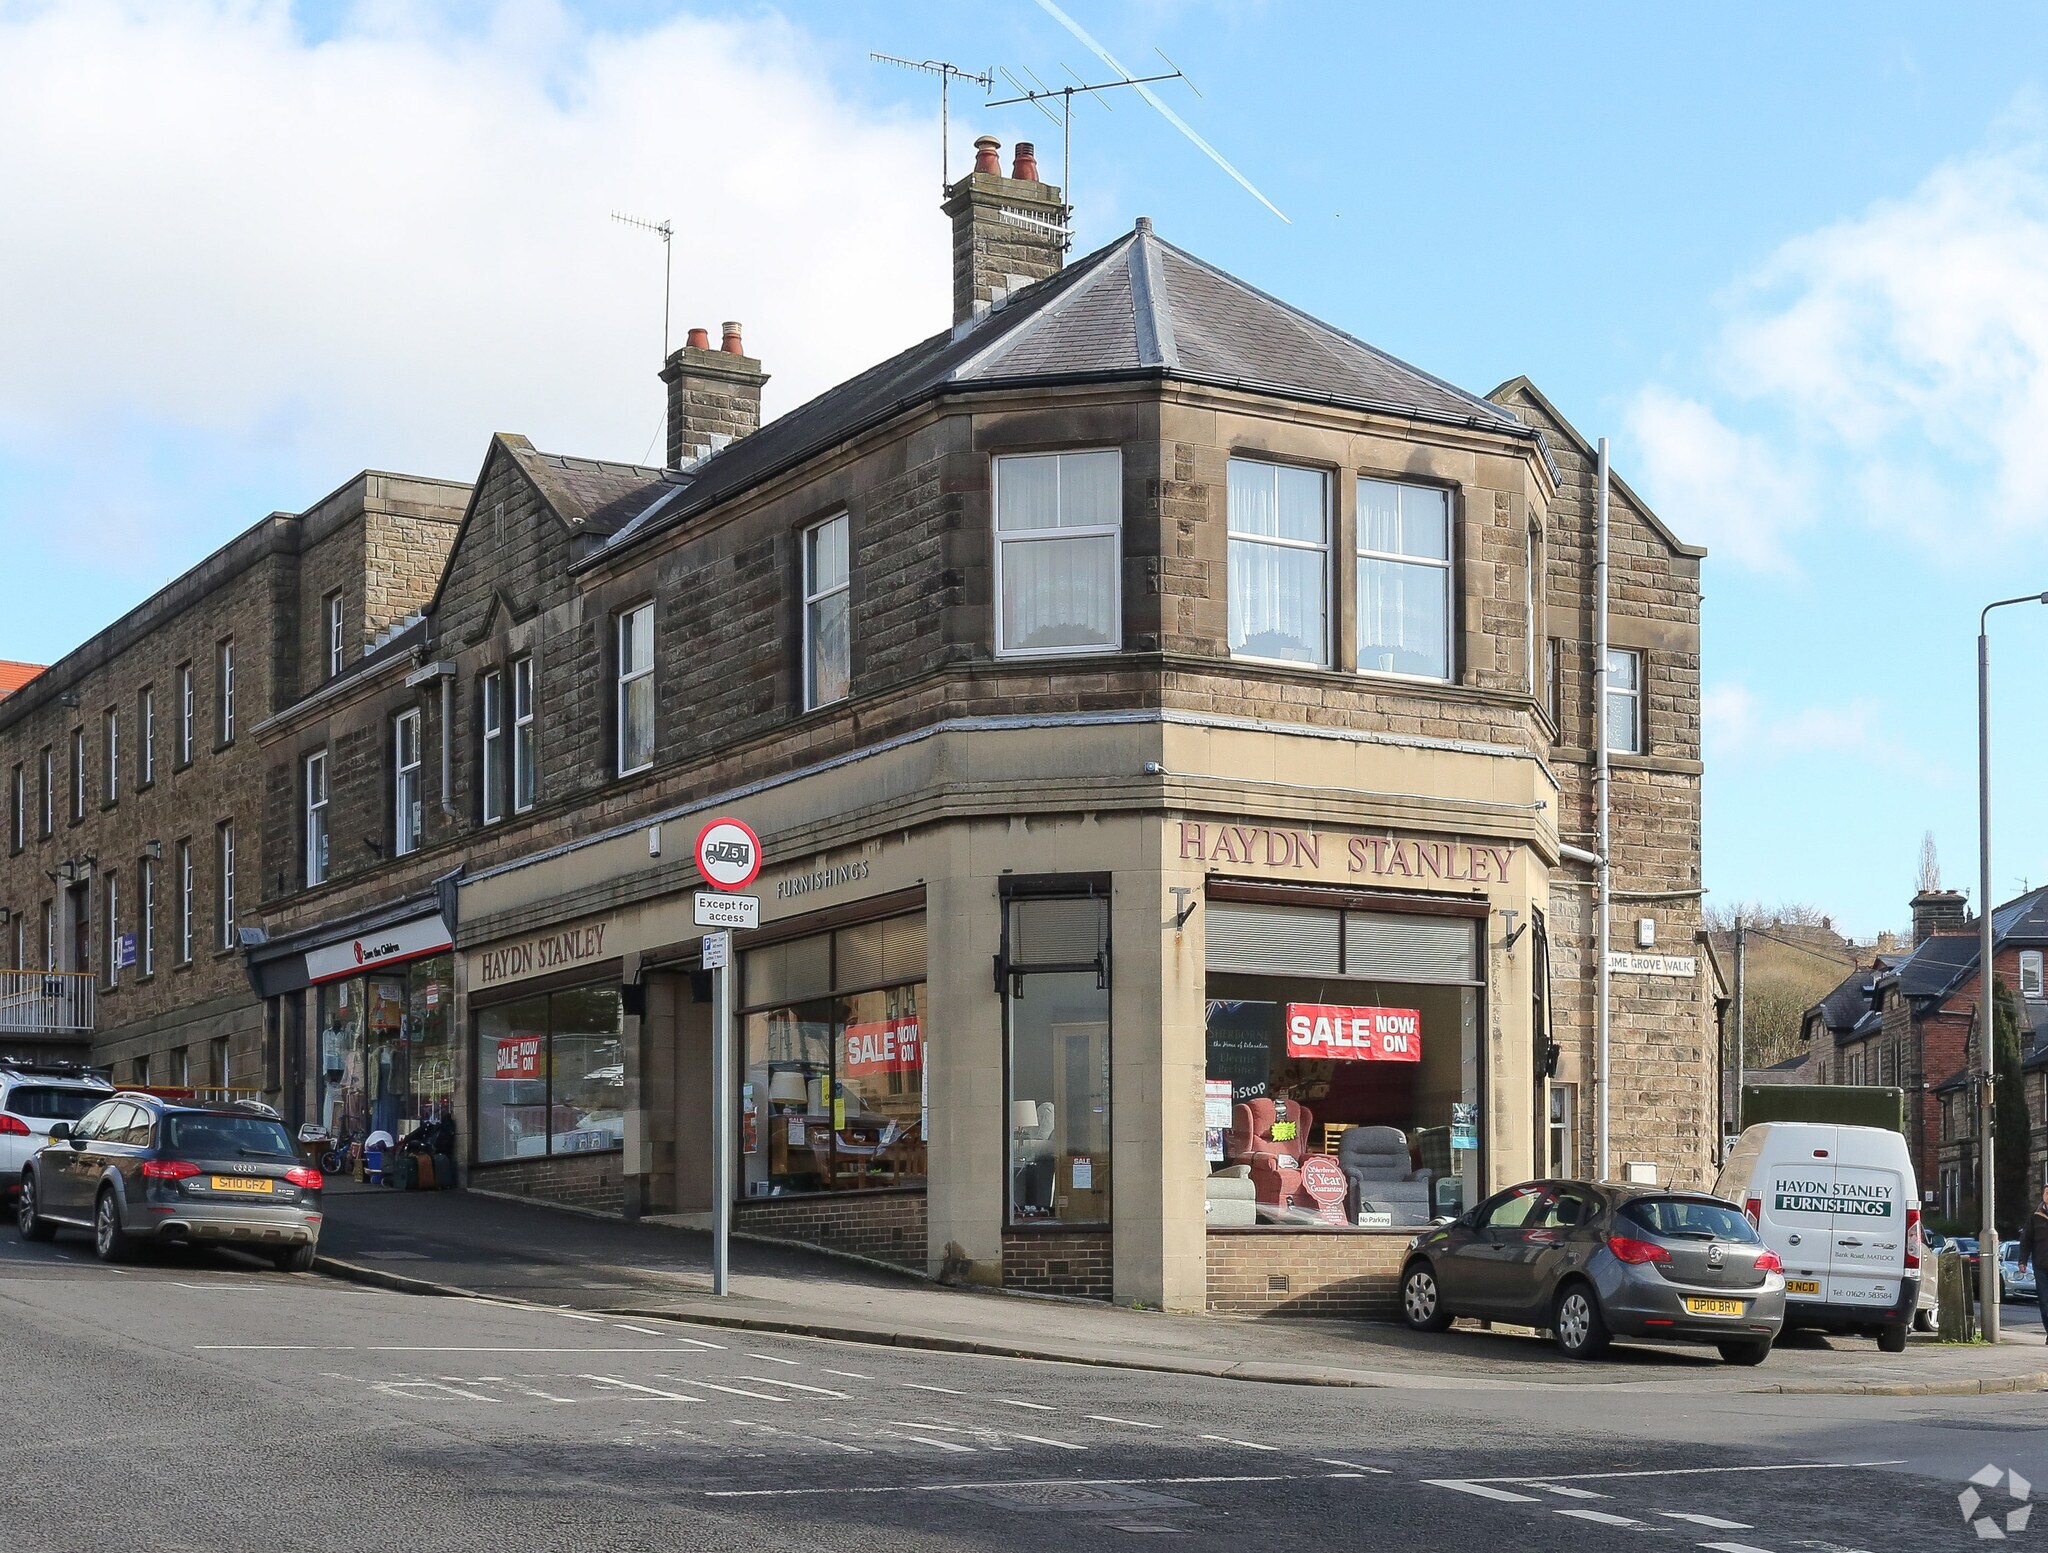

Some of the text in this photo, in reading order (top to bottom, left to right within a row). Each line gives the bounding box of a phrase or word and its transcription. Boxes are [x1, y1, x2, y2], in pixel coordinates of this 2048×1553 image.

[1178, 821, 1514, 884] HAYDN STANLEY
[776, 859, 868, 899] FURNISHINGS
[700, 898, 754, 911] Except for
[709, 912, 744, 922] access
[364, 950, 374, 960] Save
[381, 942, 400, 955] Children
[481, 923, 606, 983] HAYDN STANLEY
[1608, 957, 1690, 972] IME GROVE WALK
[896, 1024, 918, 1043] NOW
[1290, 1015, 1371, 1047] SALE
[1375, 1015, 1415, 1034] NOW
[520, 1041, 538, 1056] NOW
[848, 1031, 896, 1065] SALE
[1383, 1035, 1407, 1052] ON
[497, 1046, 518, 1071] SALE
[901, 1044, 914, 1062] ON
[523, 1056, 534, 1070] ON
[246, 1179, 266, 1190] GFZ
[1308, 1174, 1340, 1186] 5 Year
[1310, 1185, 1343, 1193] Guarantee
[1775, 1180, 1893, 1198] HAYDN STANLEY
[1782, 1196, 1884, 1215] FURNISHINGS
[1796, 1282, 1815, 1291] NCD
[1694, 1300, 1737, 1313] DP10 BRV
